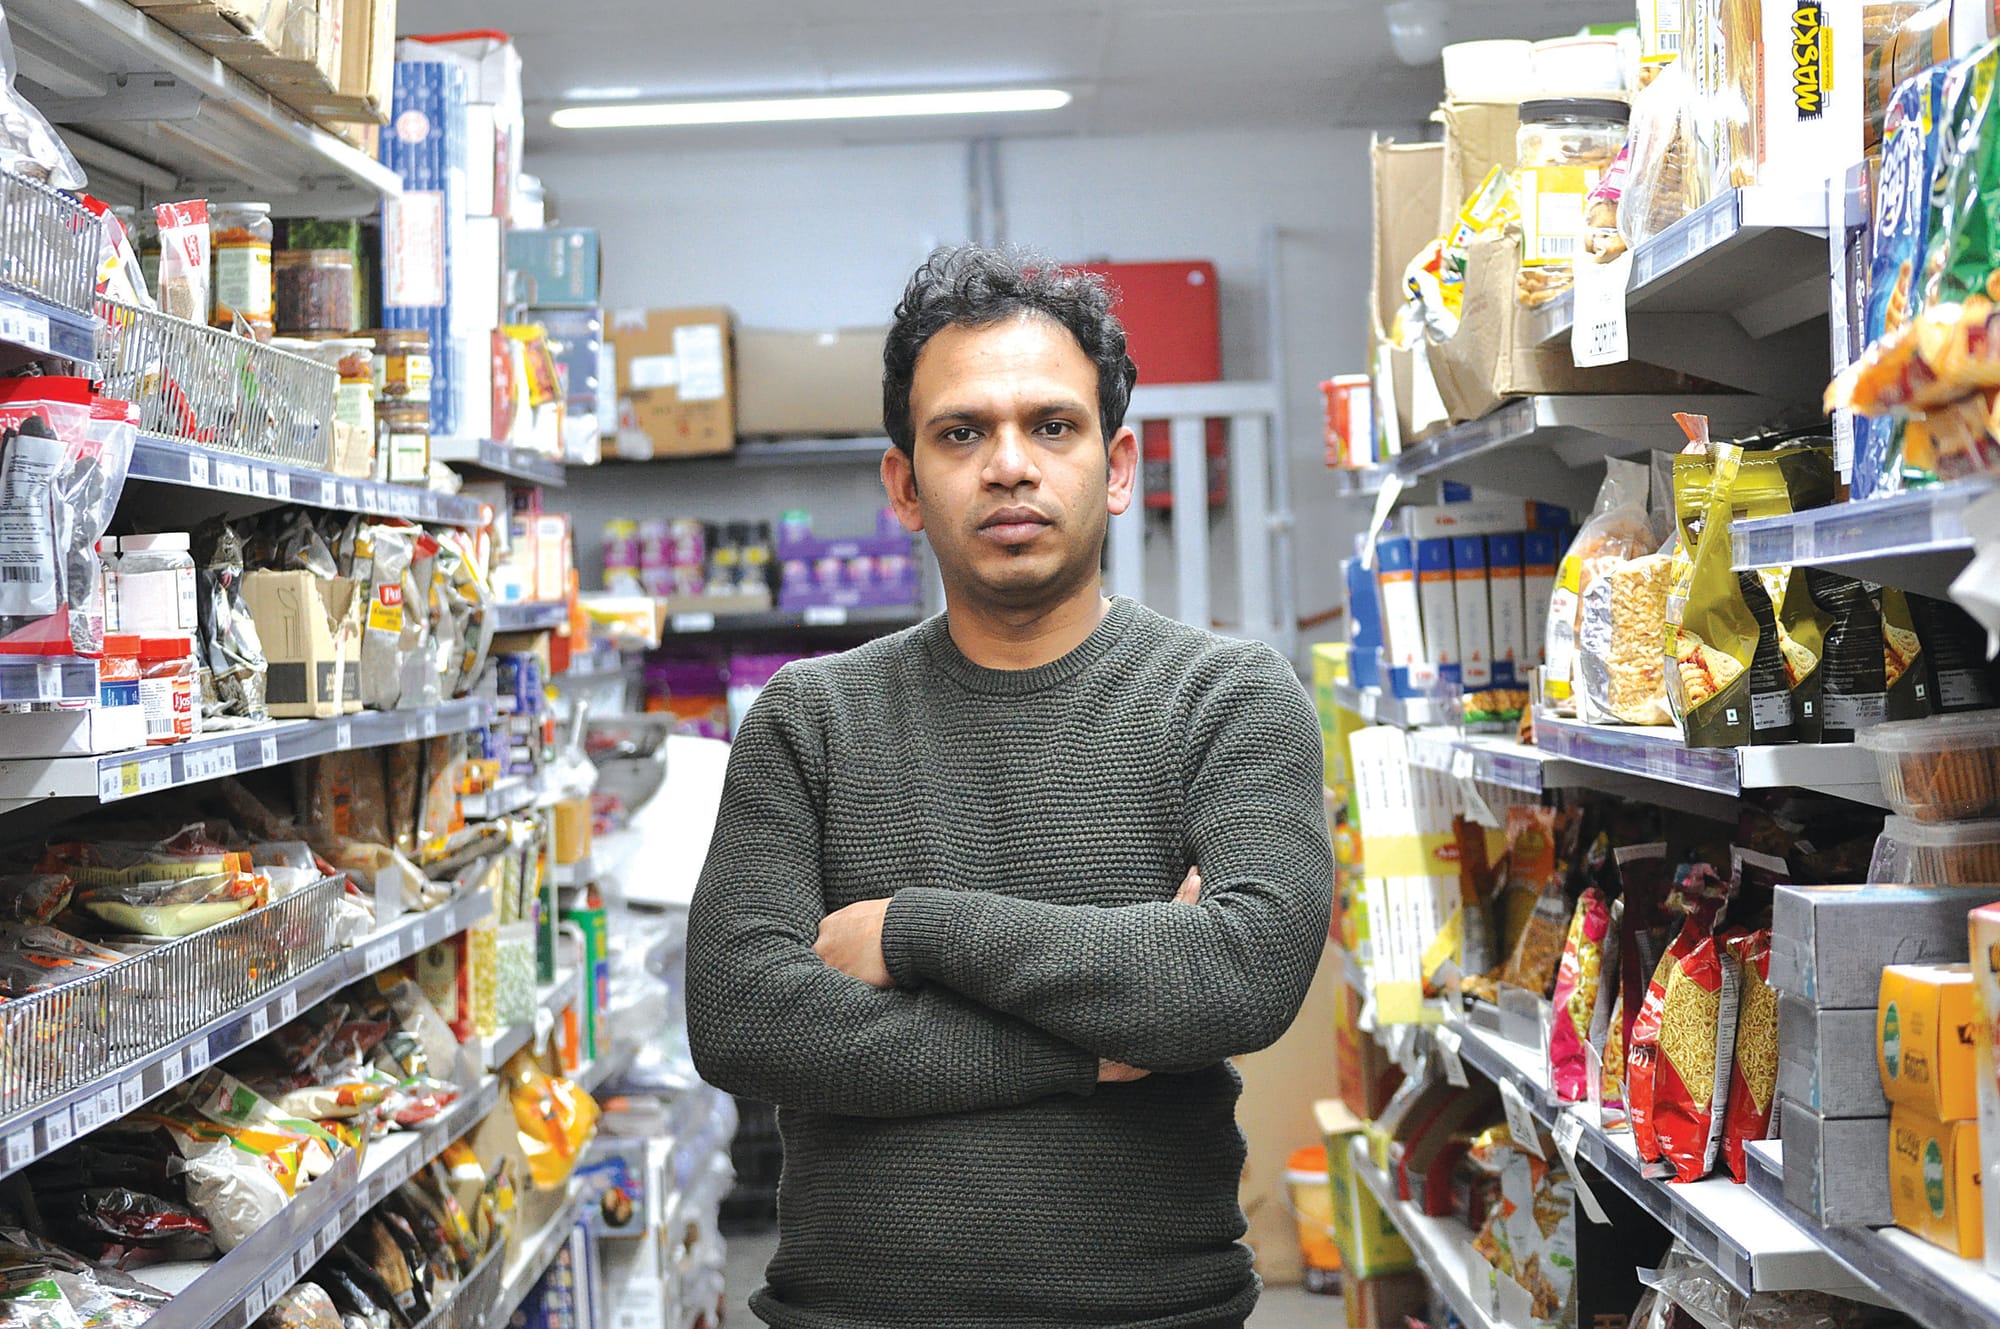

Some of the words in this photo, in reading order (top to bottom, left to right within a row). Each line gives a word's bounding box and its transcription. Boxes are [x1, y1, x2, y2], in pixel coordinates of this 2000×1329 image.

[1791, 7, 1819, 111] MASKA
[1855, 229, 1863, 278] HIDE
[1856, 277, 1866, 308] &
